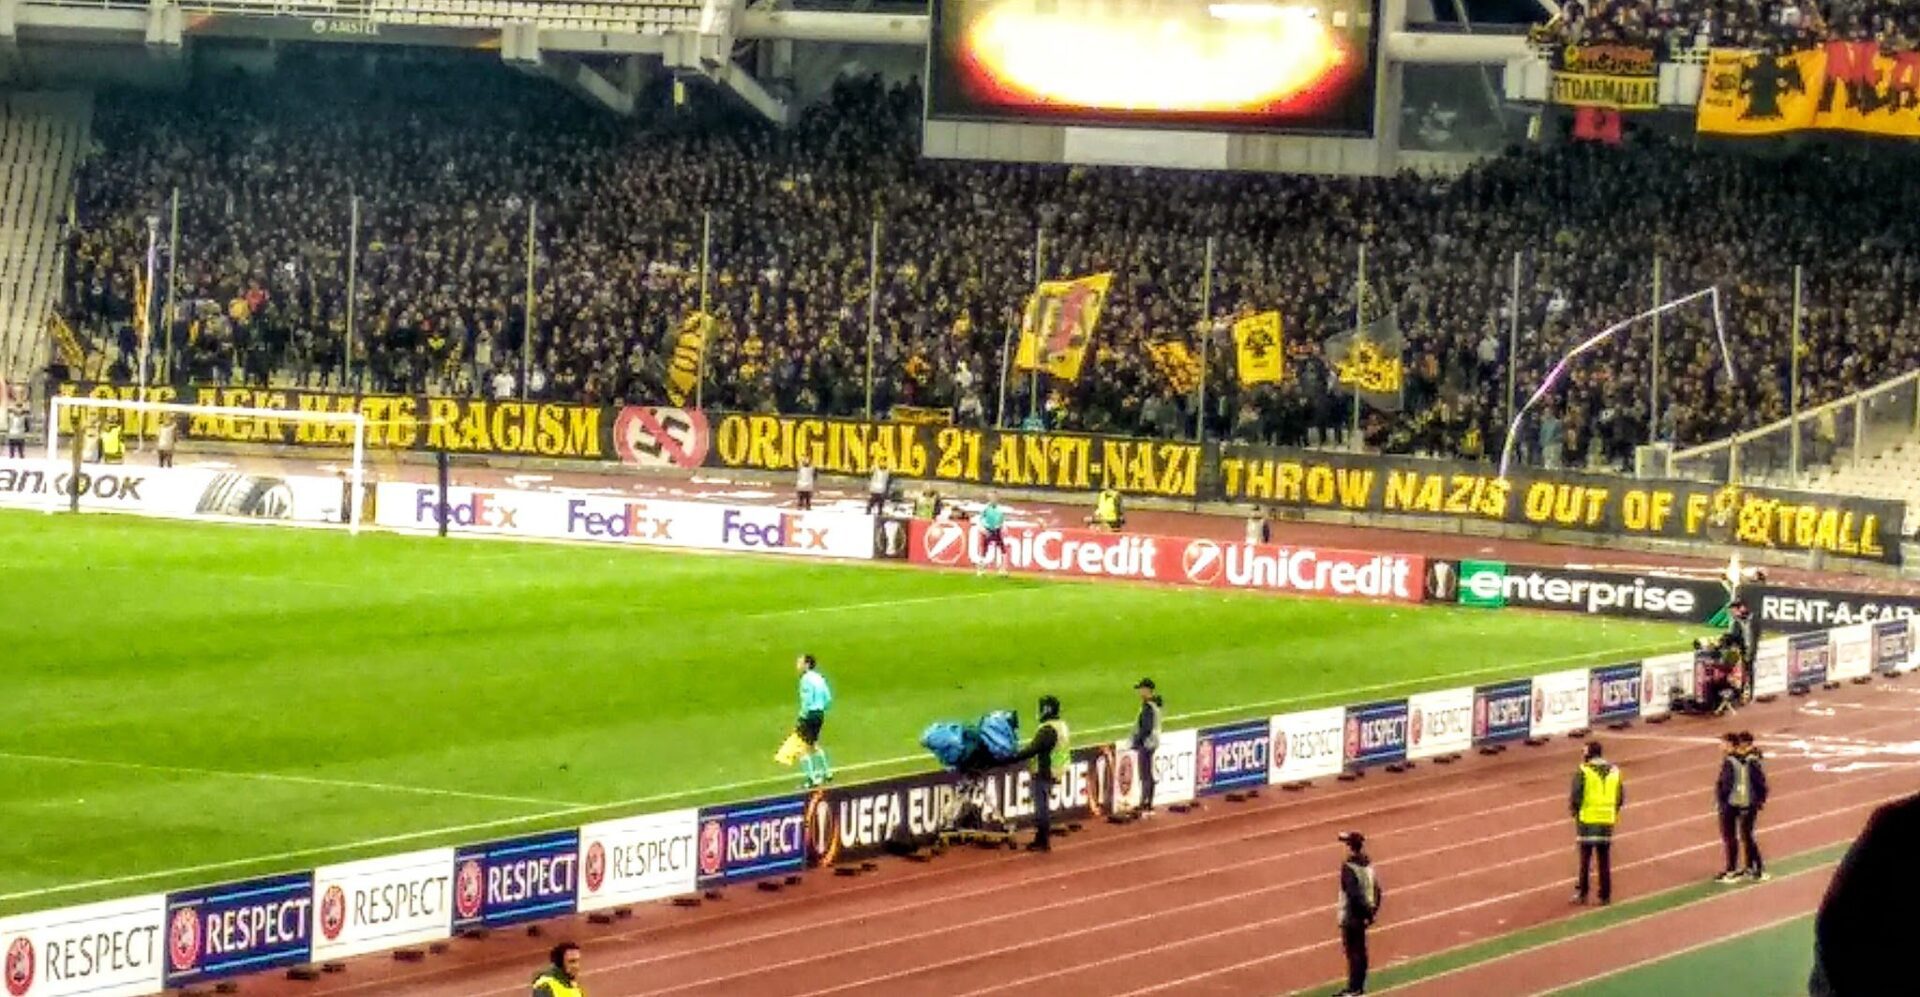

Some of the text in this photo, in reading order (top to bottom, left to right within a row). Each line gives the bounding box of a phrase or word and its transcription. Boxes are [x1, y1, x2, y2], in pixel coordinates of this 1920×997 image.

[424, 397, 601, 456] RACISM
[718, 415, 1201, 497] ORIGINAL 21 ANTI-NAZI
[416, 488, 518, 529] FedEx
[1221, 457, 1376, 509] THROW
[1384, 467, 1511, 518] NAZIS
[1526, 480, 1608, 524] OUT
[1623, 489, 1674, 532] OF
[568, 499, 673, 540] FedEx
[722, 509, 829, 551] FedEx
[969, 526, 1156, 578] UniCredit
[1226, 545, 1409, 598] UniCredit
[1470, 570, 1695, 614] enterprise
[1215, 736, 1269, 772] RESPECT
[1291, 727, 1341, 759] RESPECT
[1361, 715, 1407, 749] RESPECT
[1154, 751, 1193, 783] SPECT
[840, 792, 901, 848] UEFA
[1004, 760, 1090, 819] LEGUE
[613, 834, 692, 879] RESPECT
[727, 817, 804, 861] RESPECT
[354, 876, 448, 925] RESPECT
[488, 853, 577, 904] RESPECT
[206, 898, 311, 955] RESPECT
[46, 924, 159, 982] RESPECT
